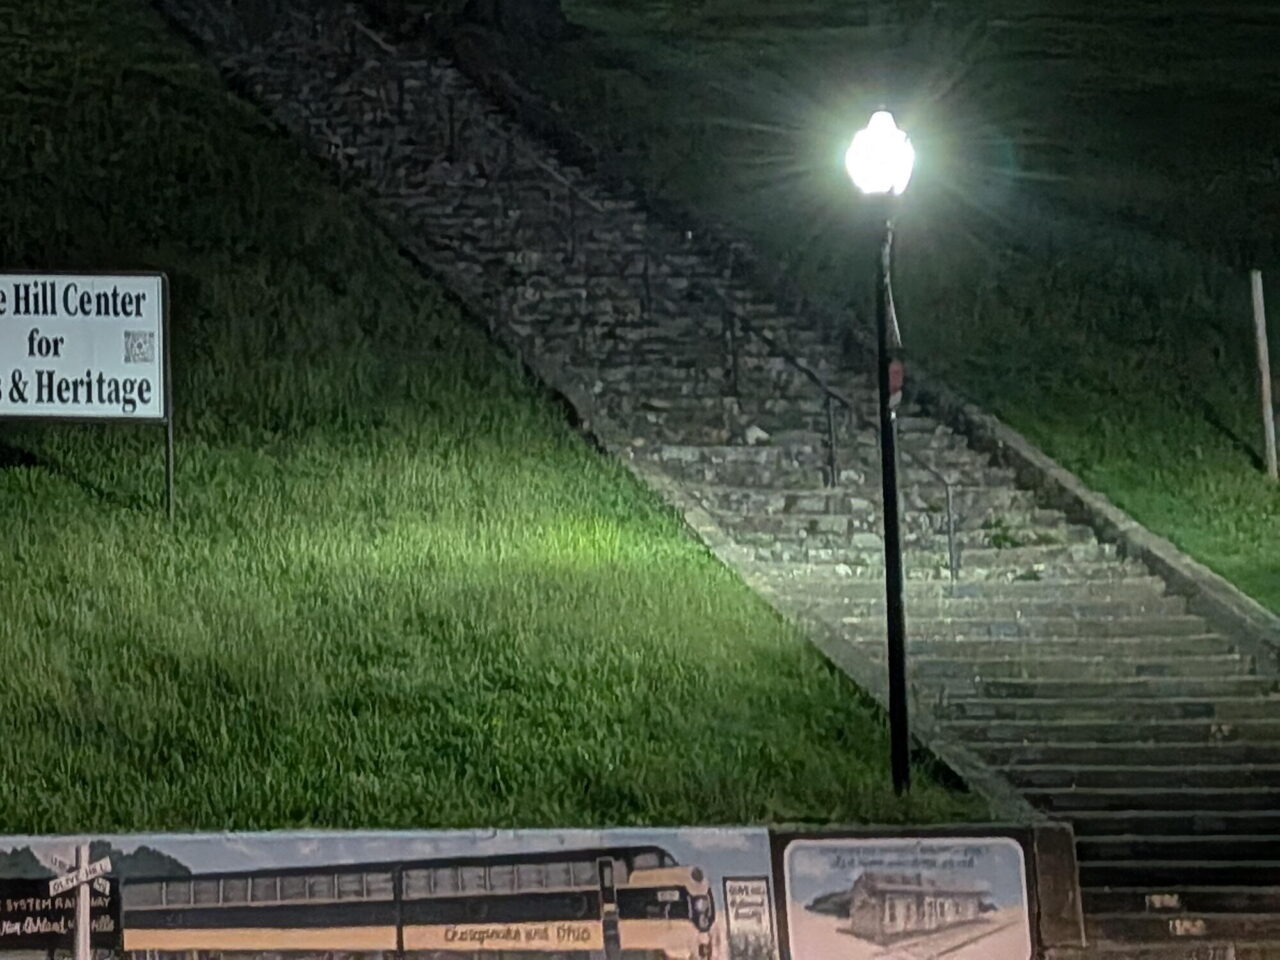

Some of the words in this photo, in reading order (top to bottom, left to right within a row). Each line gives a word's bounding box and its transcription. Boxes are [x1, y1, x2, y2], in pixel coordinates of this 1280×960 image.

[13, 281, 58, 316] Hill
[62, 282, 147, 317] Center
[27, 327, 65, 358] for
[8, 368, 29, 404] &
[34, 368, 152, 414] Heritage
[6, 898, 51, 912] SYSTEM
[54, 896, 111, 909] RAIWAY
